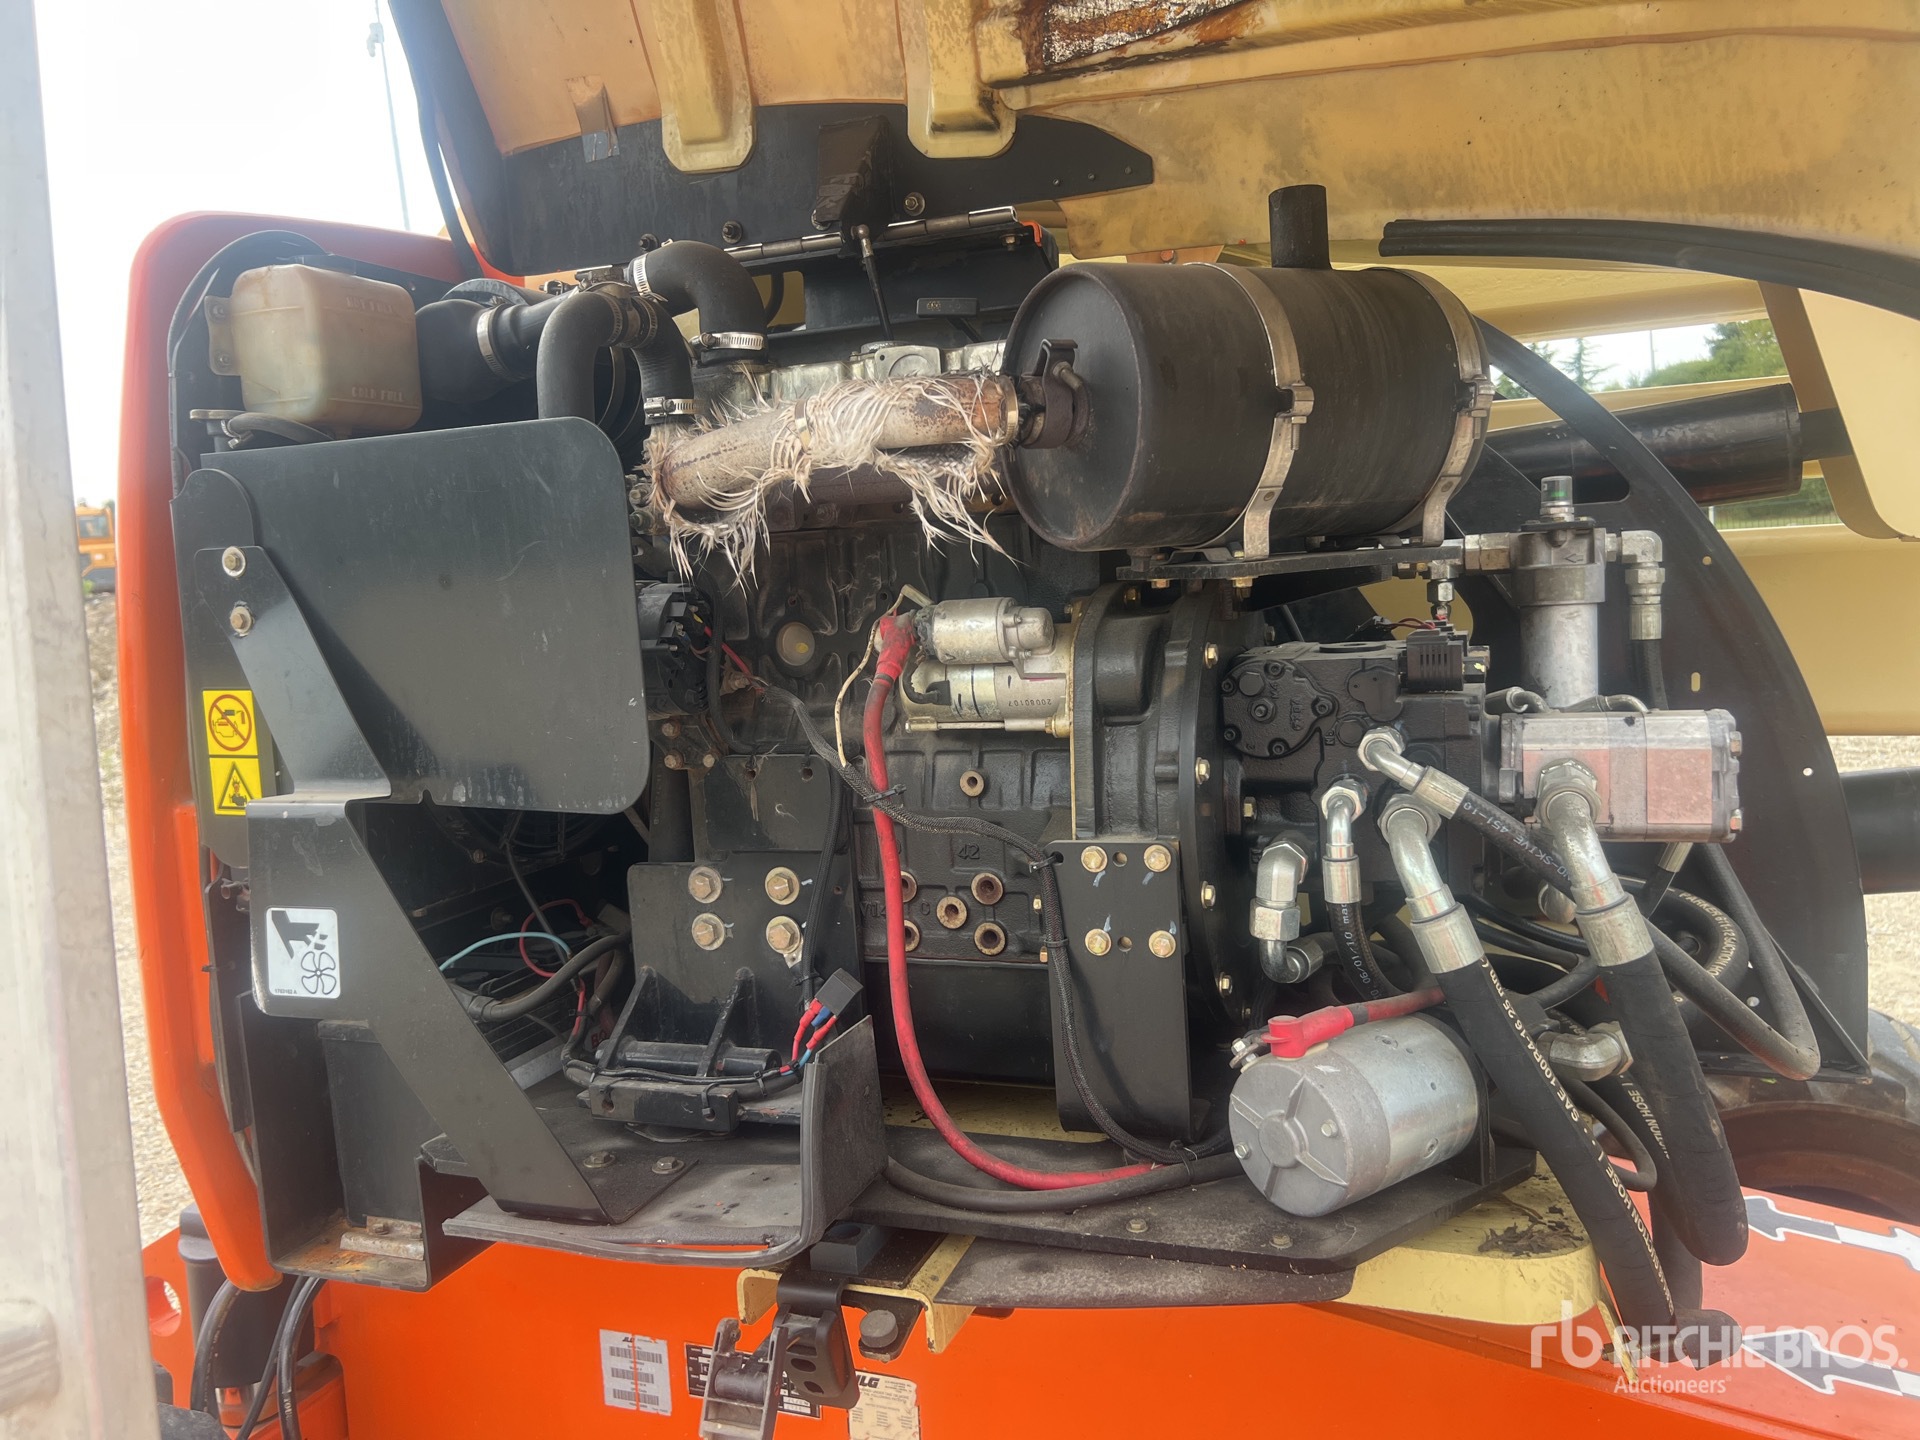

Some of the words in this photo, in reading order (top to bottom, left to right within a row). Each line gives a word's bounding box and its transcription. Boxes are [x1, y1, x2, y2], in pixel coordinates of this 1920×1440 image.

[1463, 801, 1510, 834] 451-10
[957, 843, 981, 860] 42
[1678, 890, 1721, 917] PARKER
[1343, 931, 1371, 984] 06/01/10
[1489, 968, 1505, 998] mm
[1502, 998, 1517, 1019] 25
[1514, 1018, 1557, 1087] 100R4-16
[1556, 1086, 1580, 1122] SAE
[1627, 1088, 1653, 1120] HOSE
[1605, 1163, 1633, 1210] HOSE
